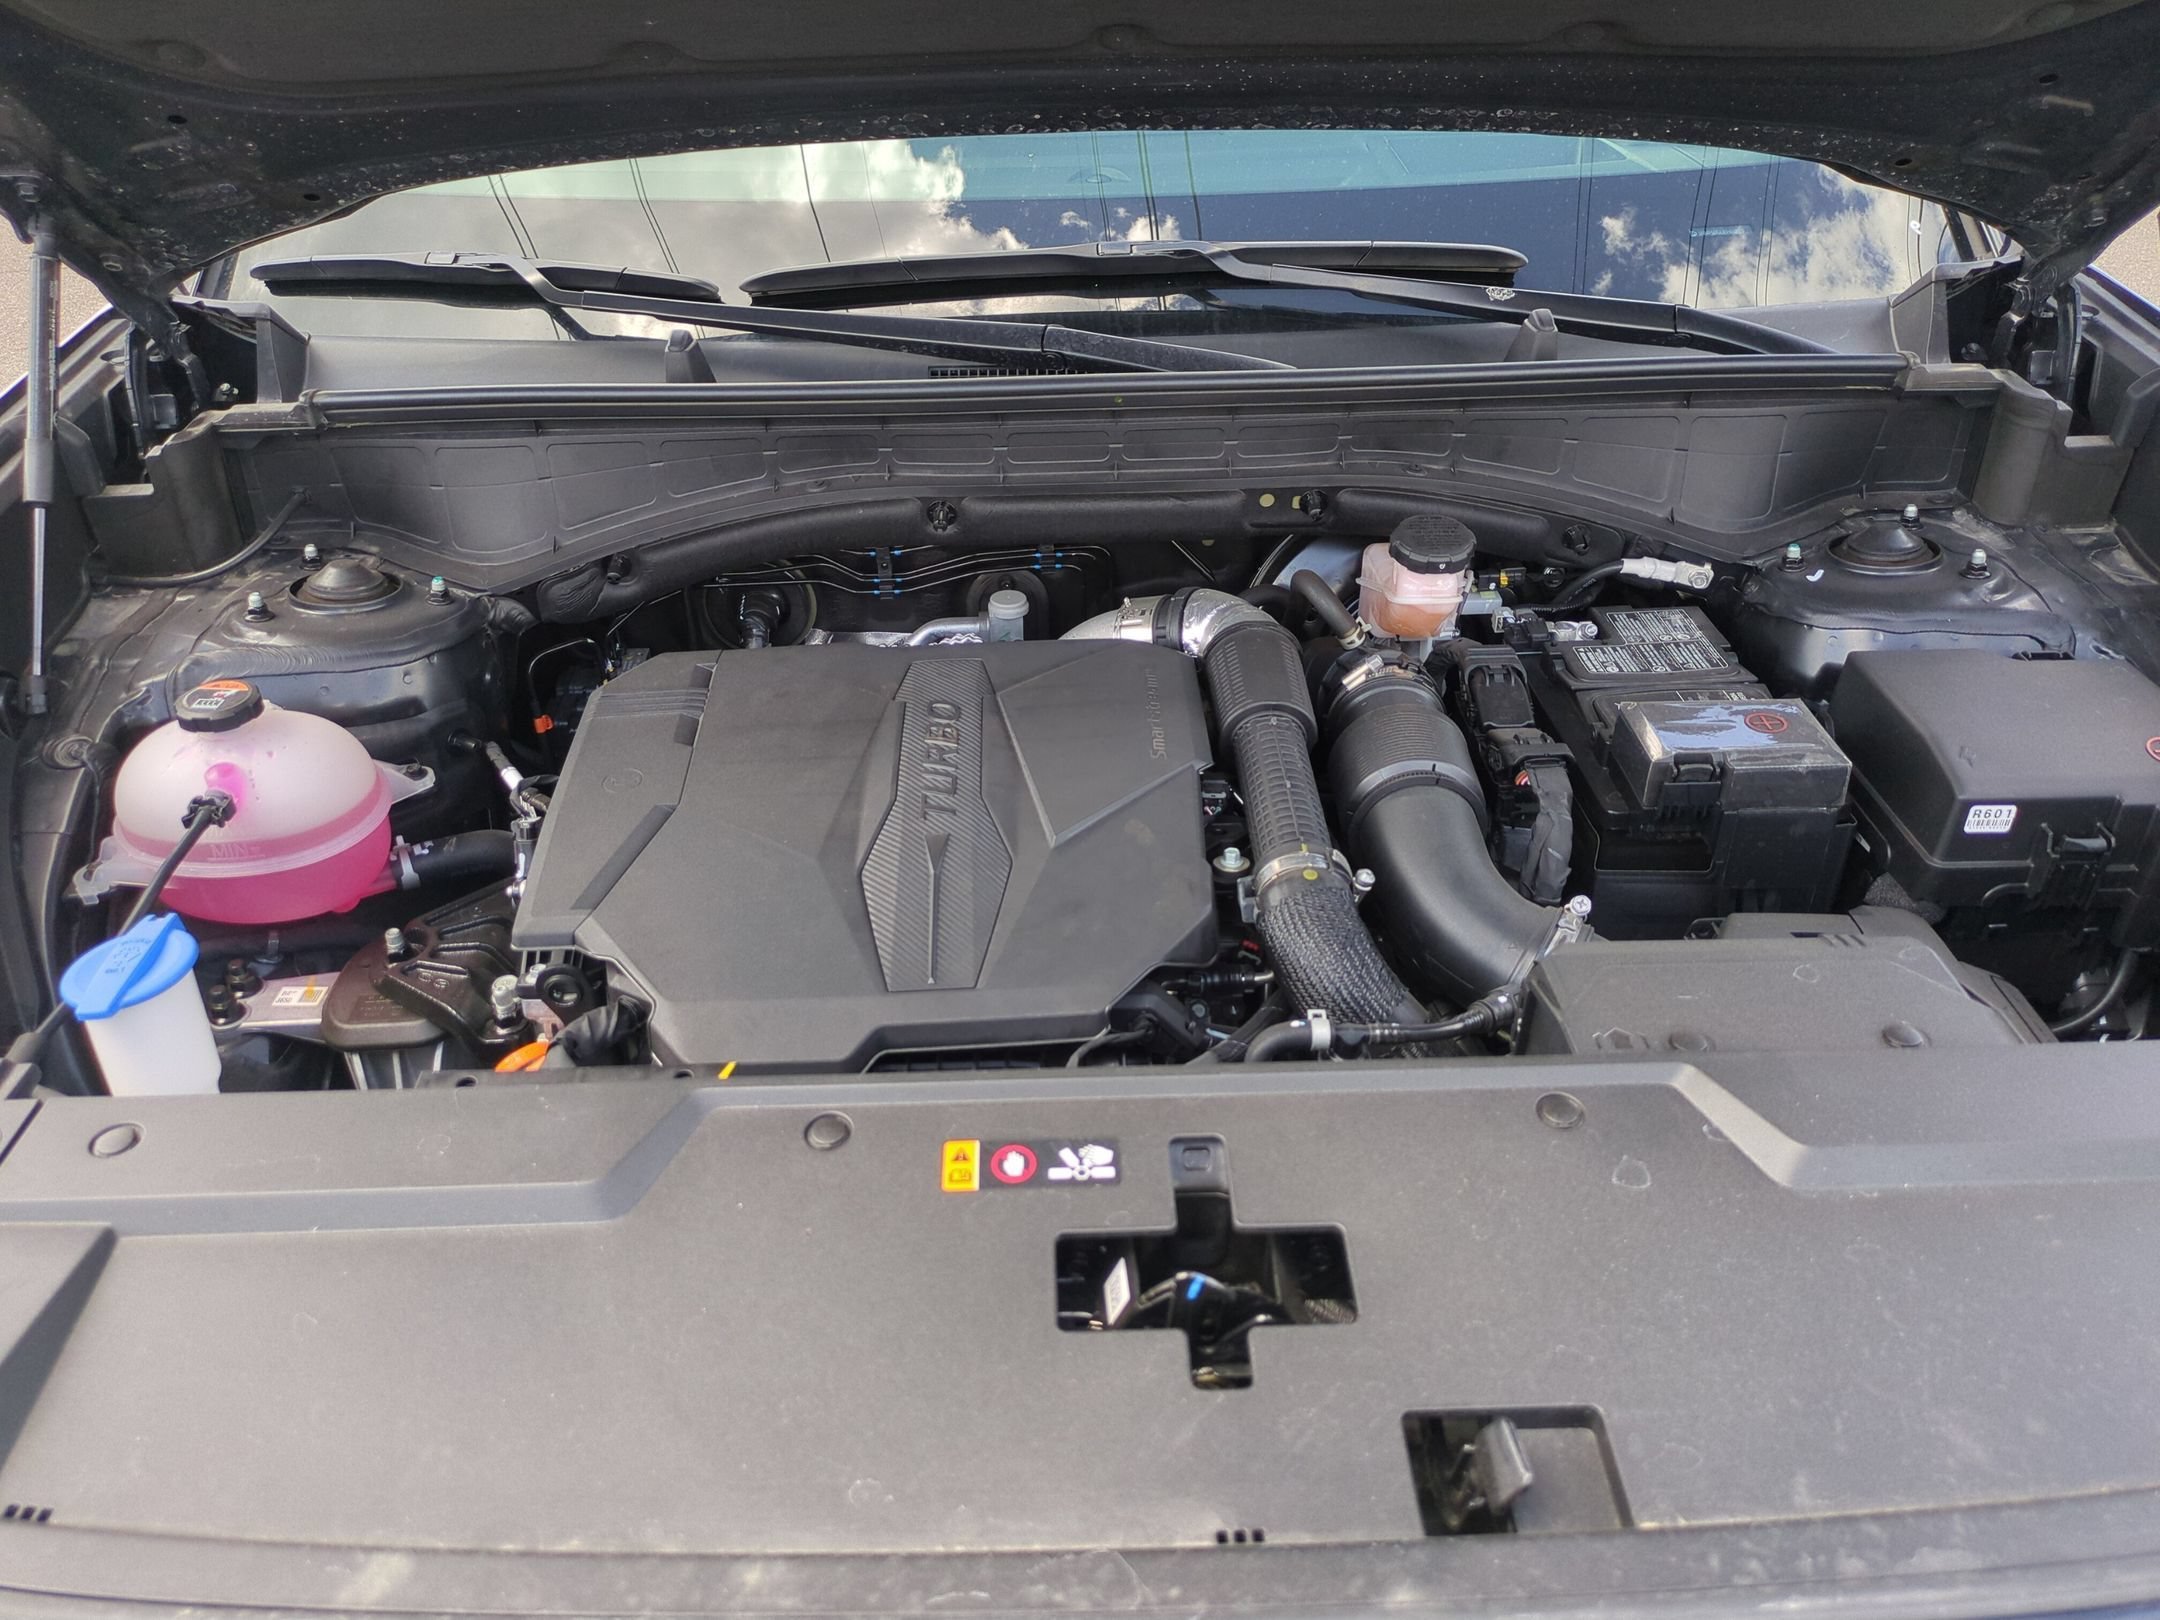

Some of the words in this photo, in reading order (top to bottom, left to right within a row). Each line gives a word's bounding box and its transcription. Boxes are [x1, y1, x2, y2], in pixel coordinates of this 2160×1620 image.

[919, 700, 961, 820] TURBO
[1972, 808, 2012, 819] R601
[210, 843, 248, 858] MIN
